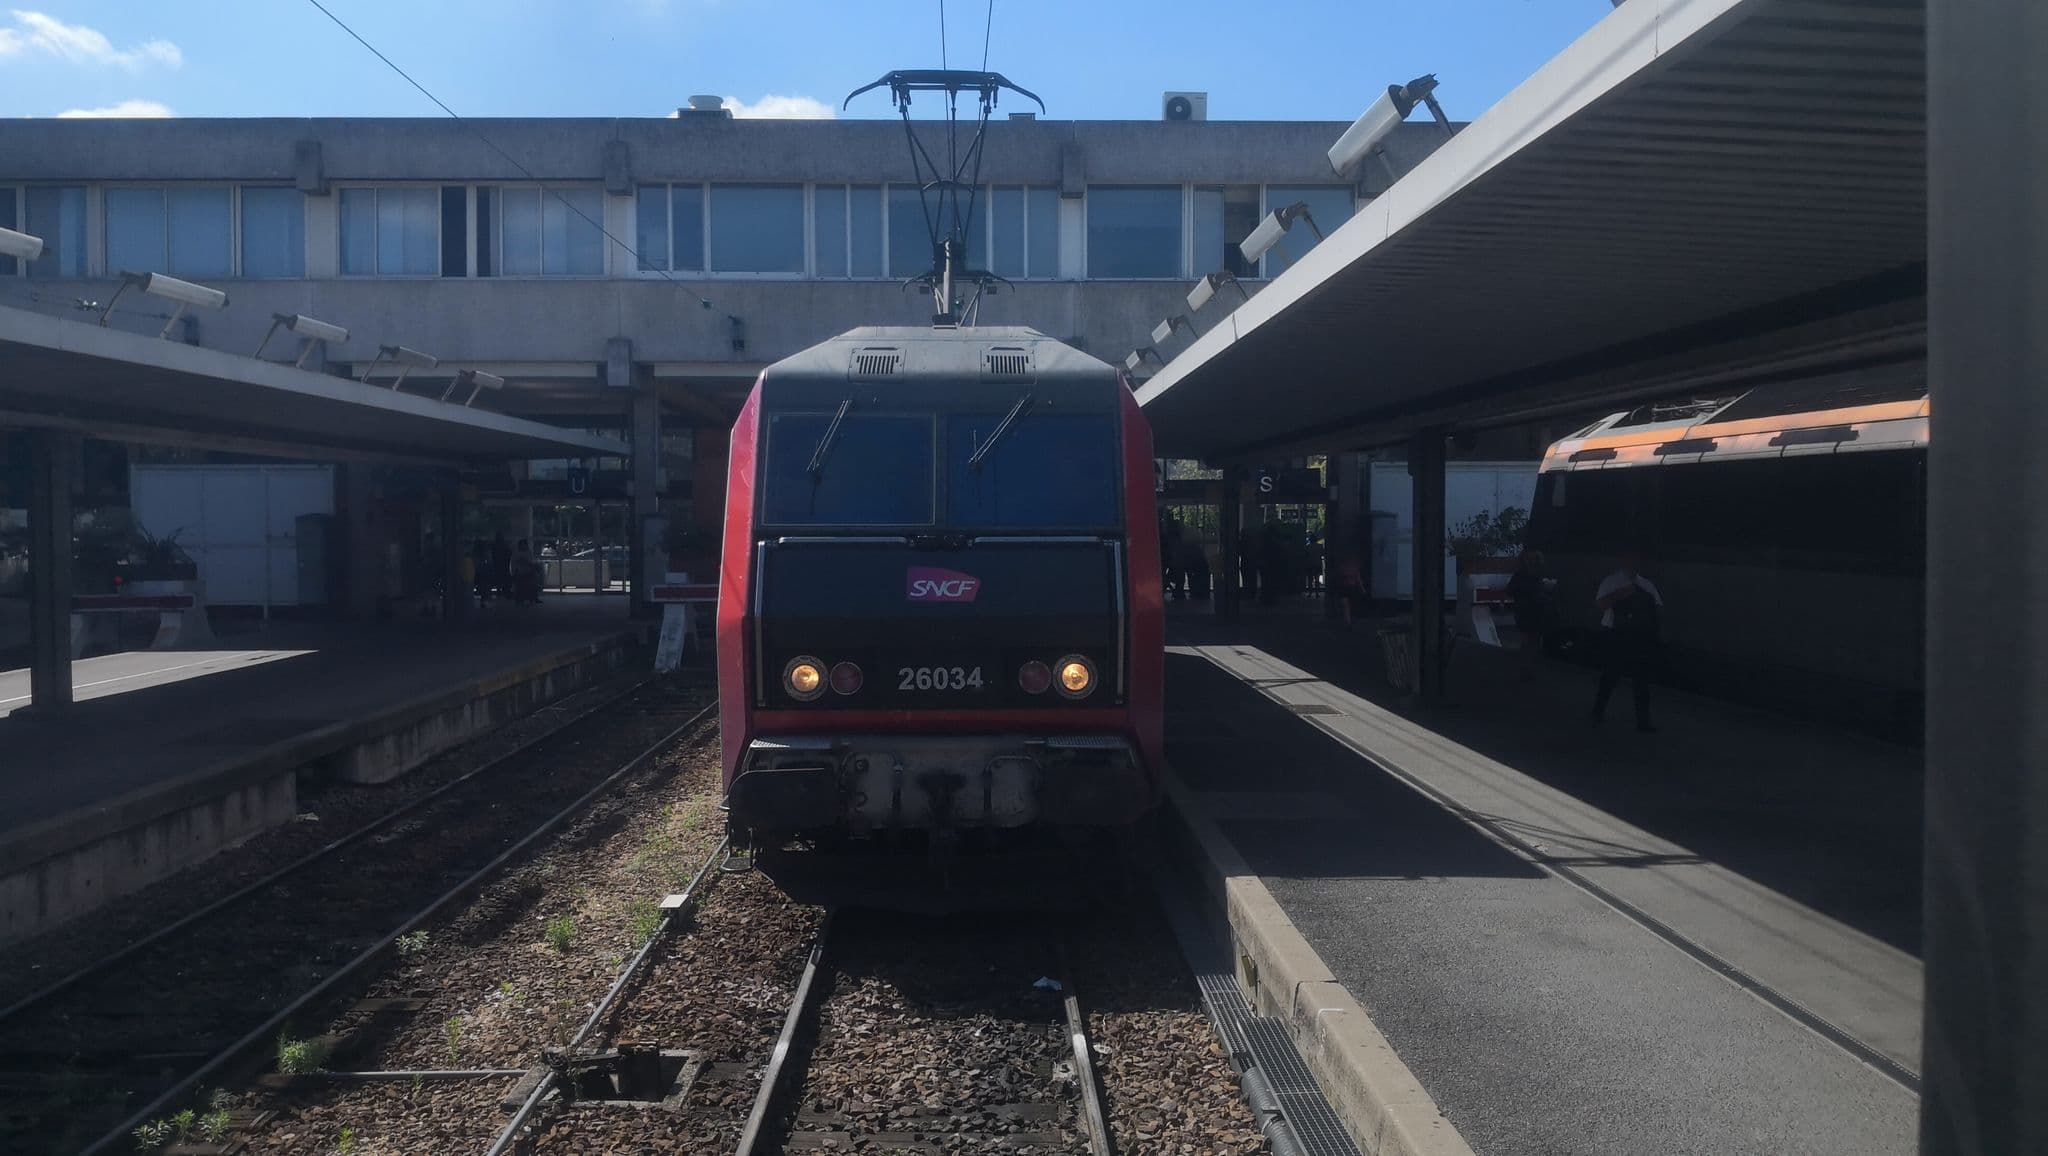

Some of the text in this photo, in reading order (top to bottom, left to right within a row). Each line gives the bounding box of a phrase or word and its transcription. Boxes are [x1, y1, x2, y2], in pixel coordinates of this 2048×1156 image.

[572, 477, 585, 494] U
[1260, 476, 1273, 493] S
[910, 580, 976, 597] SNCF
[898, 666, 984, 690] 26034
